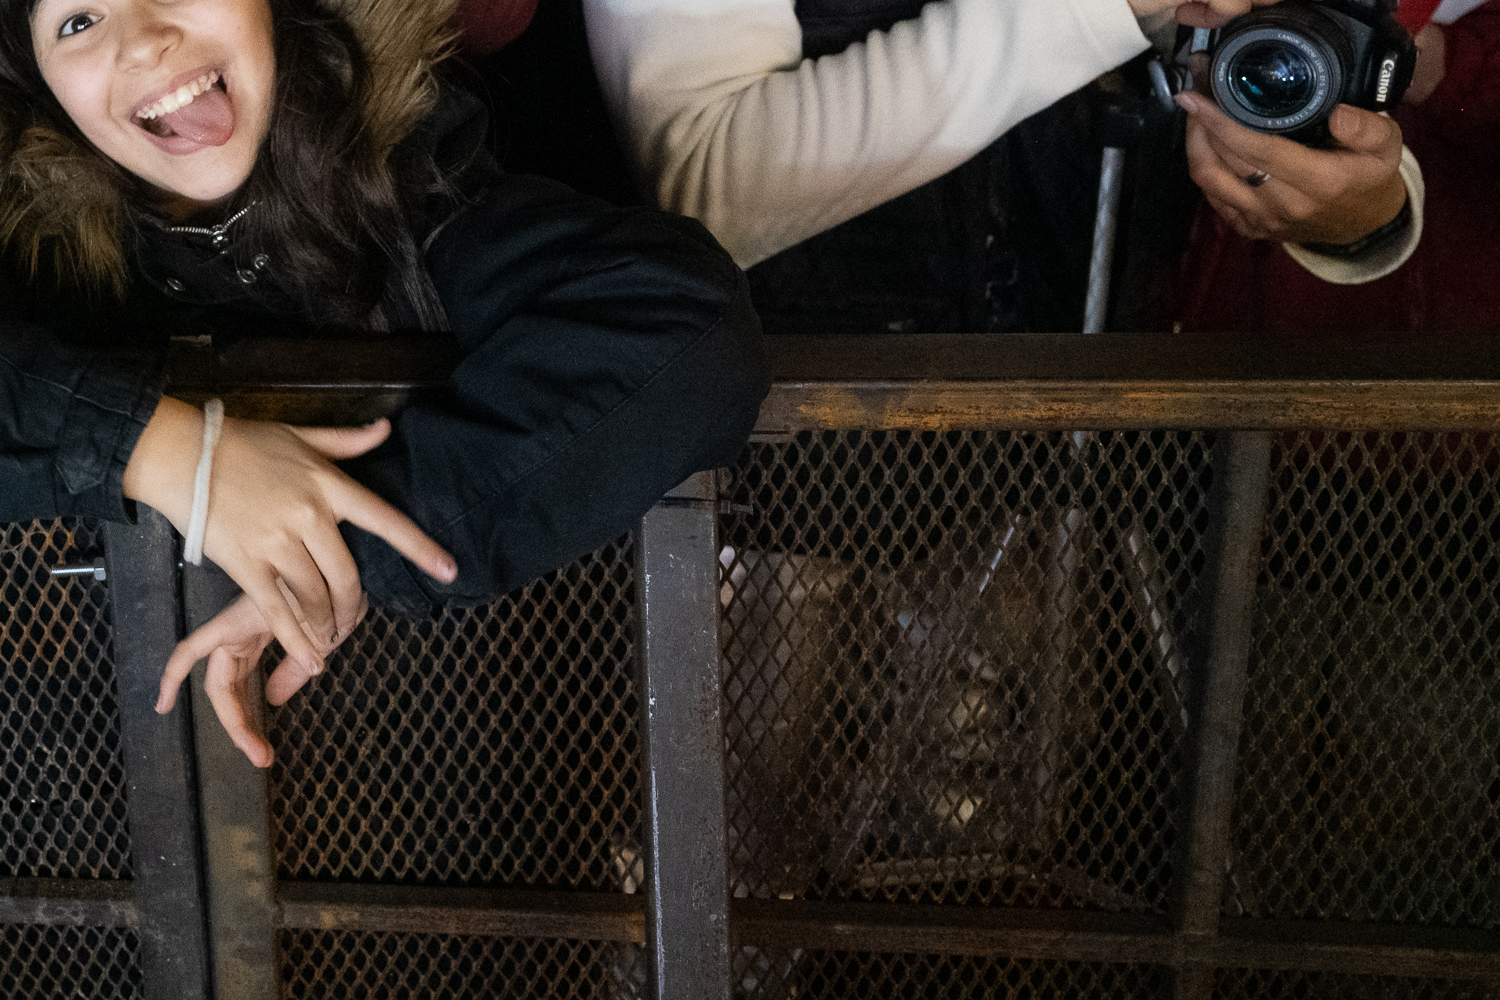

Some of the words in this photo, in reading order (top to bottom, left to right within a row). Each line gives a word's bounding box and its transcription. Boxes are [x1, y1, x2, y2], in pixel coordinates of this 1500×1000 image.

[1277, 33, 1300, 45] CANON
[1300, 43, 1317, 58] ZOOM
[1376, 59, 1395, 102] Canon
